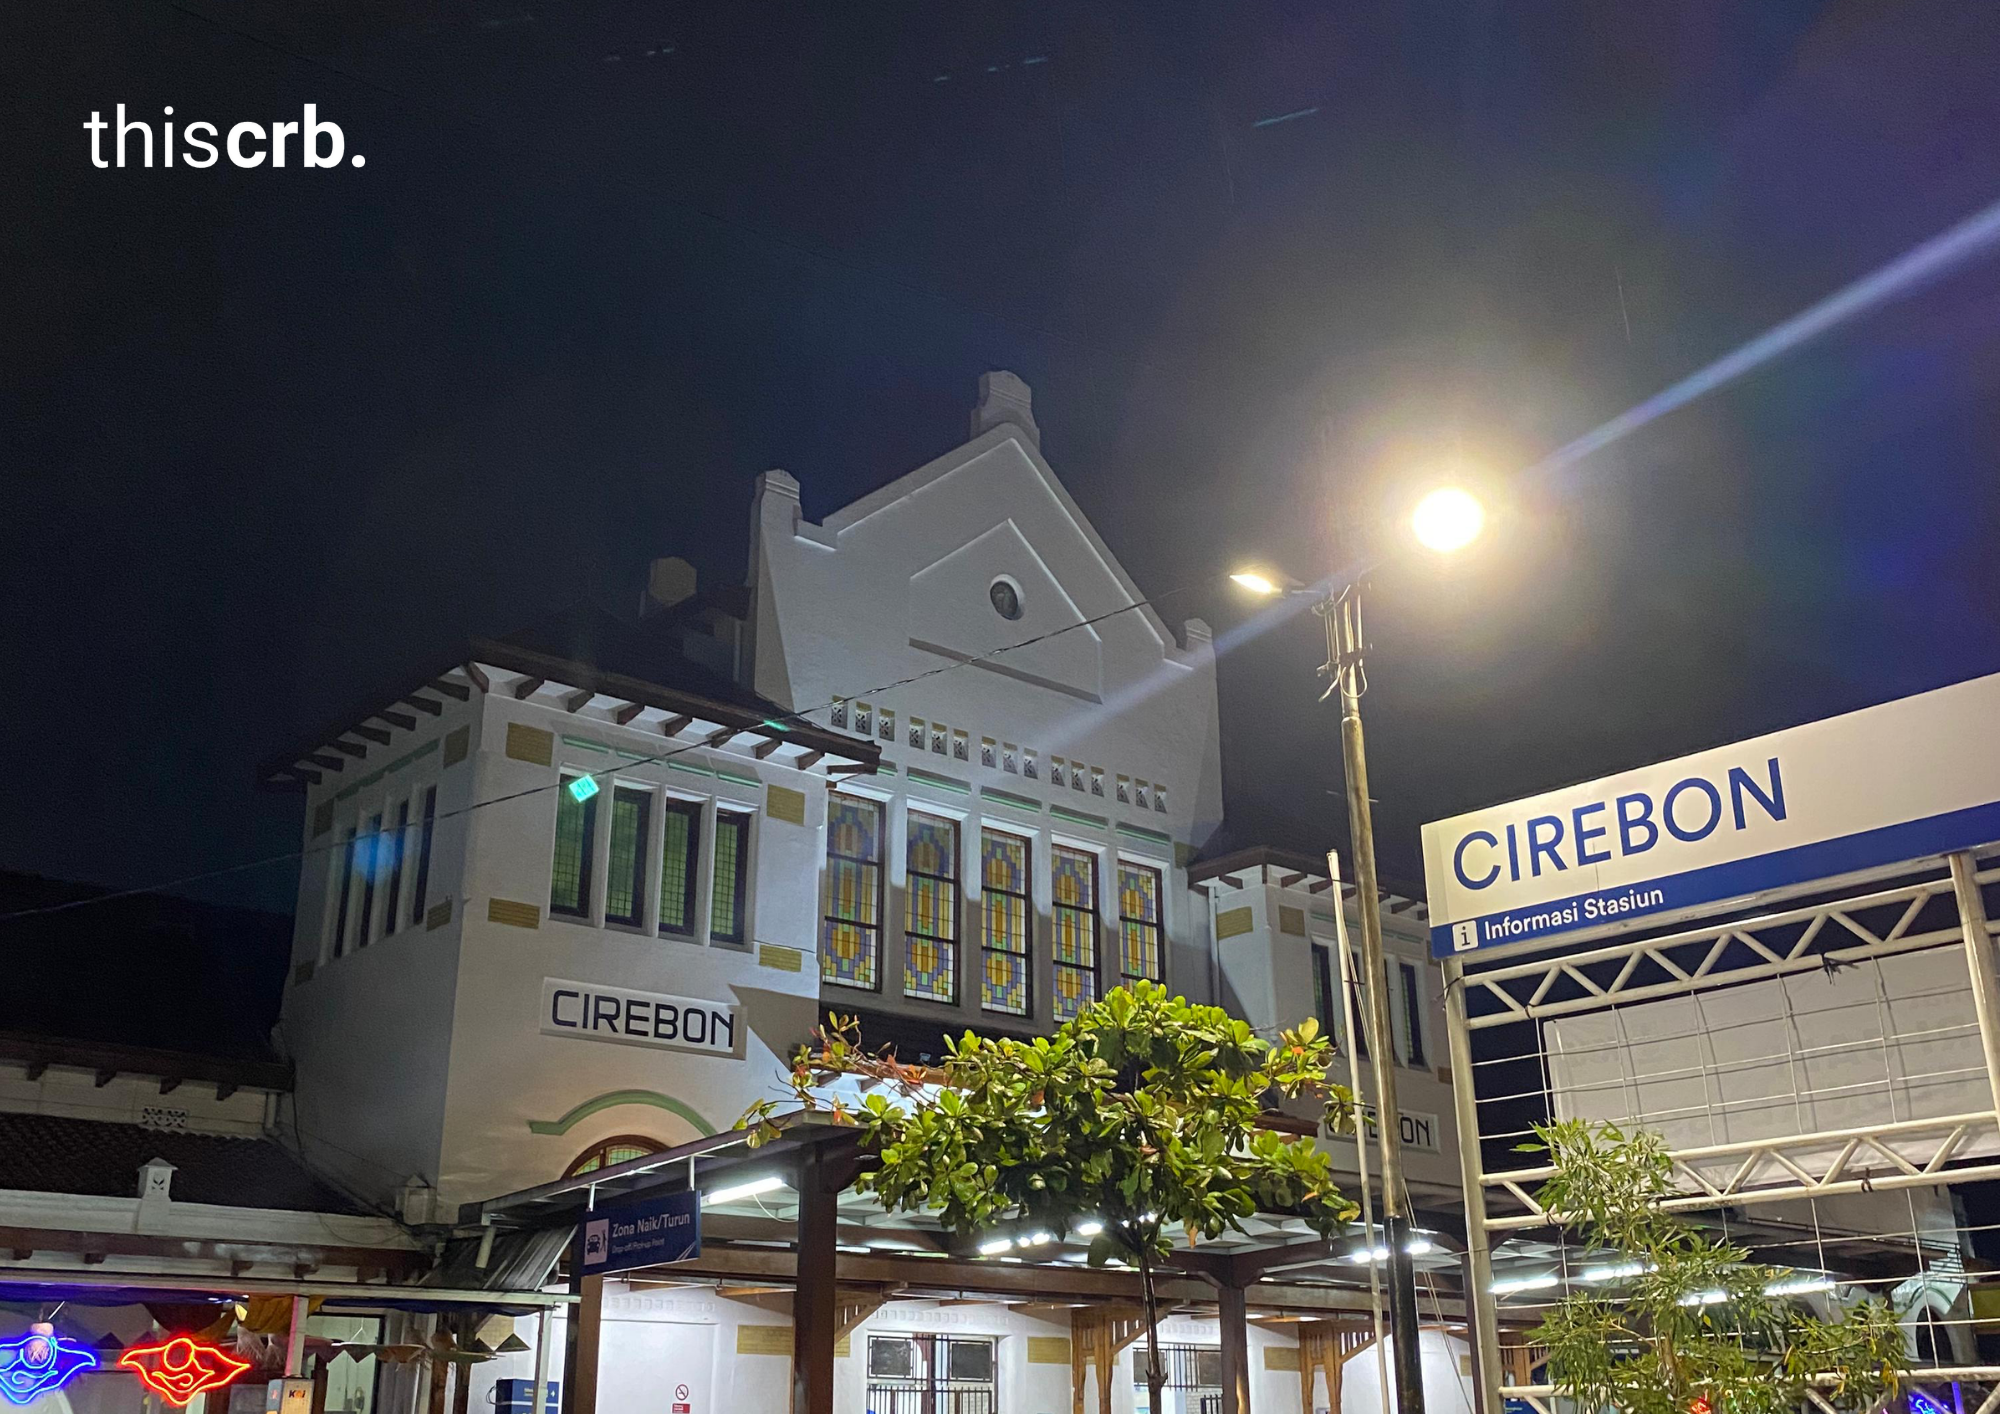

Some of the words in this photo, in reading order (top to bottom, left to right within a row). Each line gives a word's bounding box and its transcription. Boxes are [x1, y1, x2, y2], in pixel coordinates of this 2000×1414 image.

[1453, 757, 1787, 890] CIREBON
[1485, 902, 1578, 940] Informasi
[1584, 889, 1664, 918] Stasiun
[552, 989, 734, 1047] CIREBON
[612, 1223, 634, 1237] Zona
[637, 1213, 690, 1233] Naik/Turun
